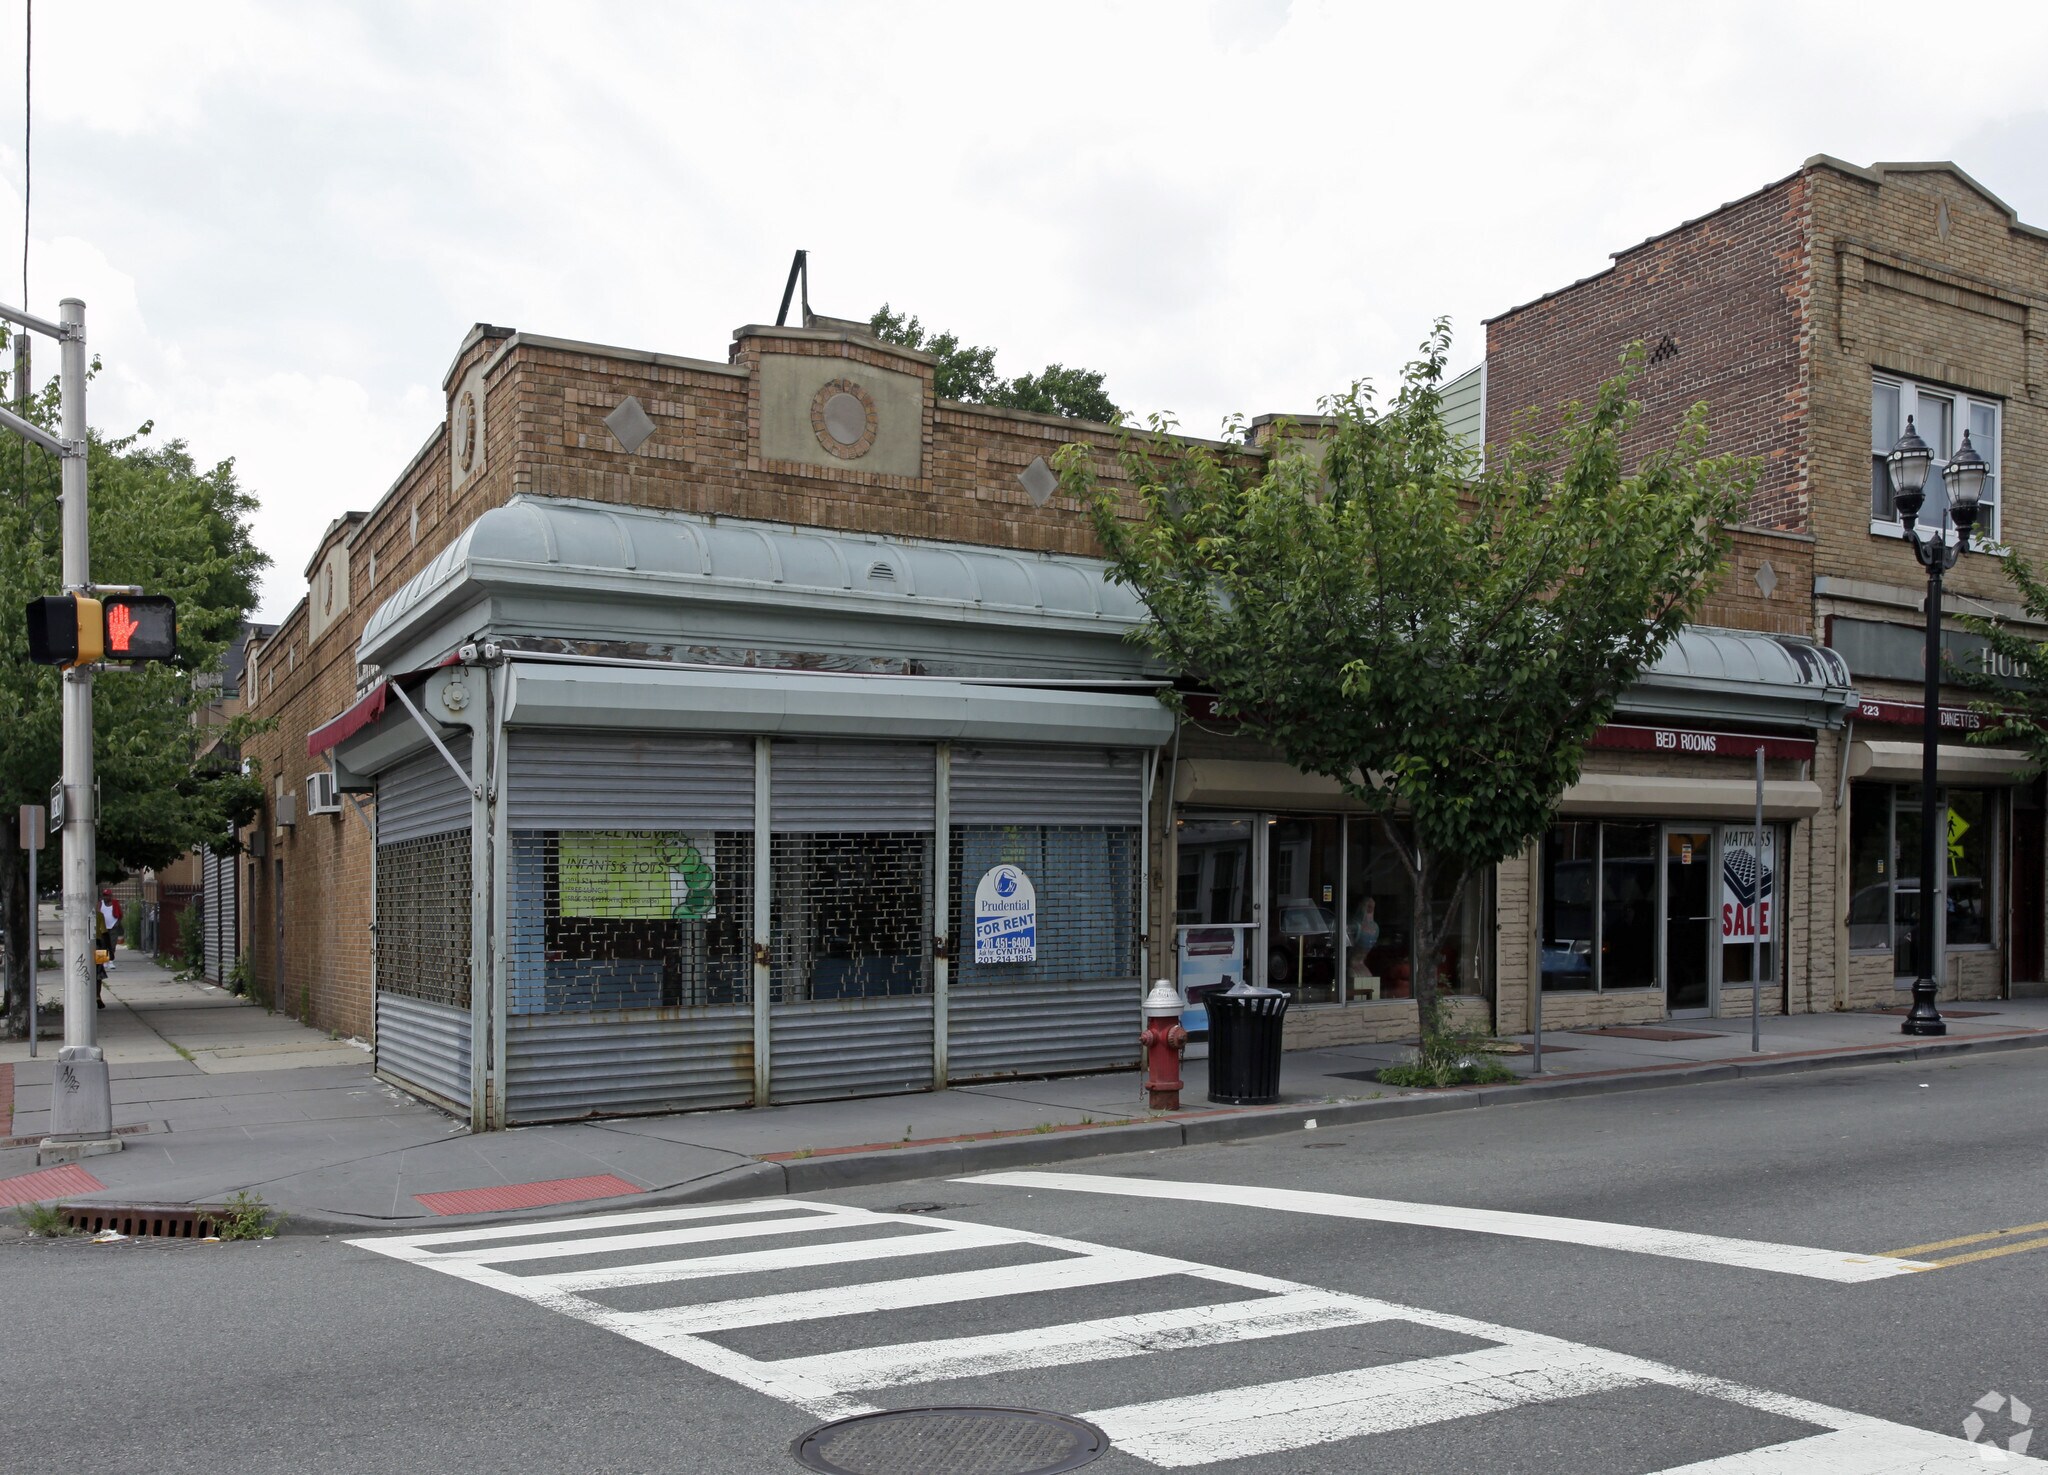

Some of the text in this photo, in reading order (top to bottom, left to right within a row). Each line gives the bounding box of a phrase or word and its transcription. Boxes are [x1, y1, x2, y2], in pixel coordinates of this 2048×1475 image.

[1862, 704, 1879, 717] 223
[1940, 711, 1980, 729] DINETTES
[1655, 731, 1717, 752] BED ROOMS
[1724, 831, 1771, 847] MATTRSS
[566, 857, 665, 874] INFANTS & TOTS
[982, 899, 1030, 911] Prudential
[976, 913, 1034, 937] FOR RENT
[1723, 902, 1769, 936] SALE
[981, 936, 1031, 949] 201 451-6400
[978, 954, 1033, 963] 201-214-1815
[996, 947, 1032, 955] CYNTHIA
